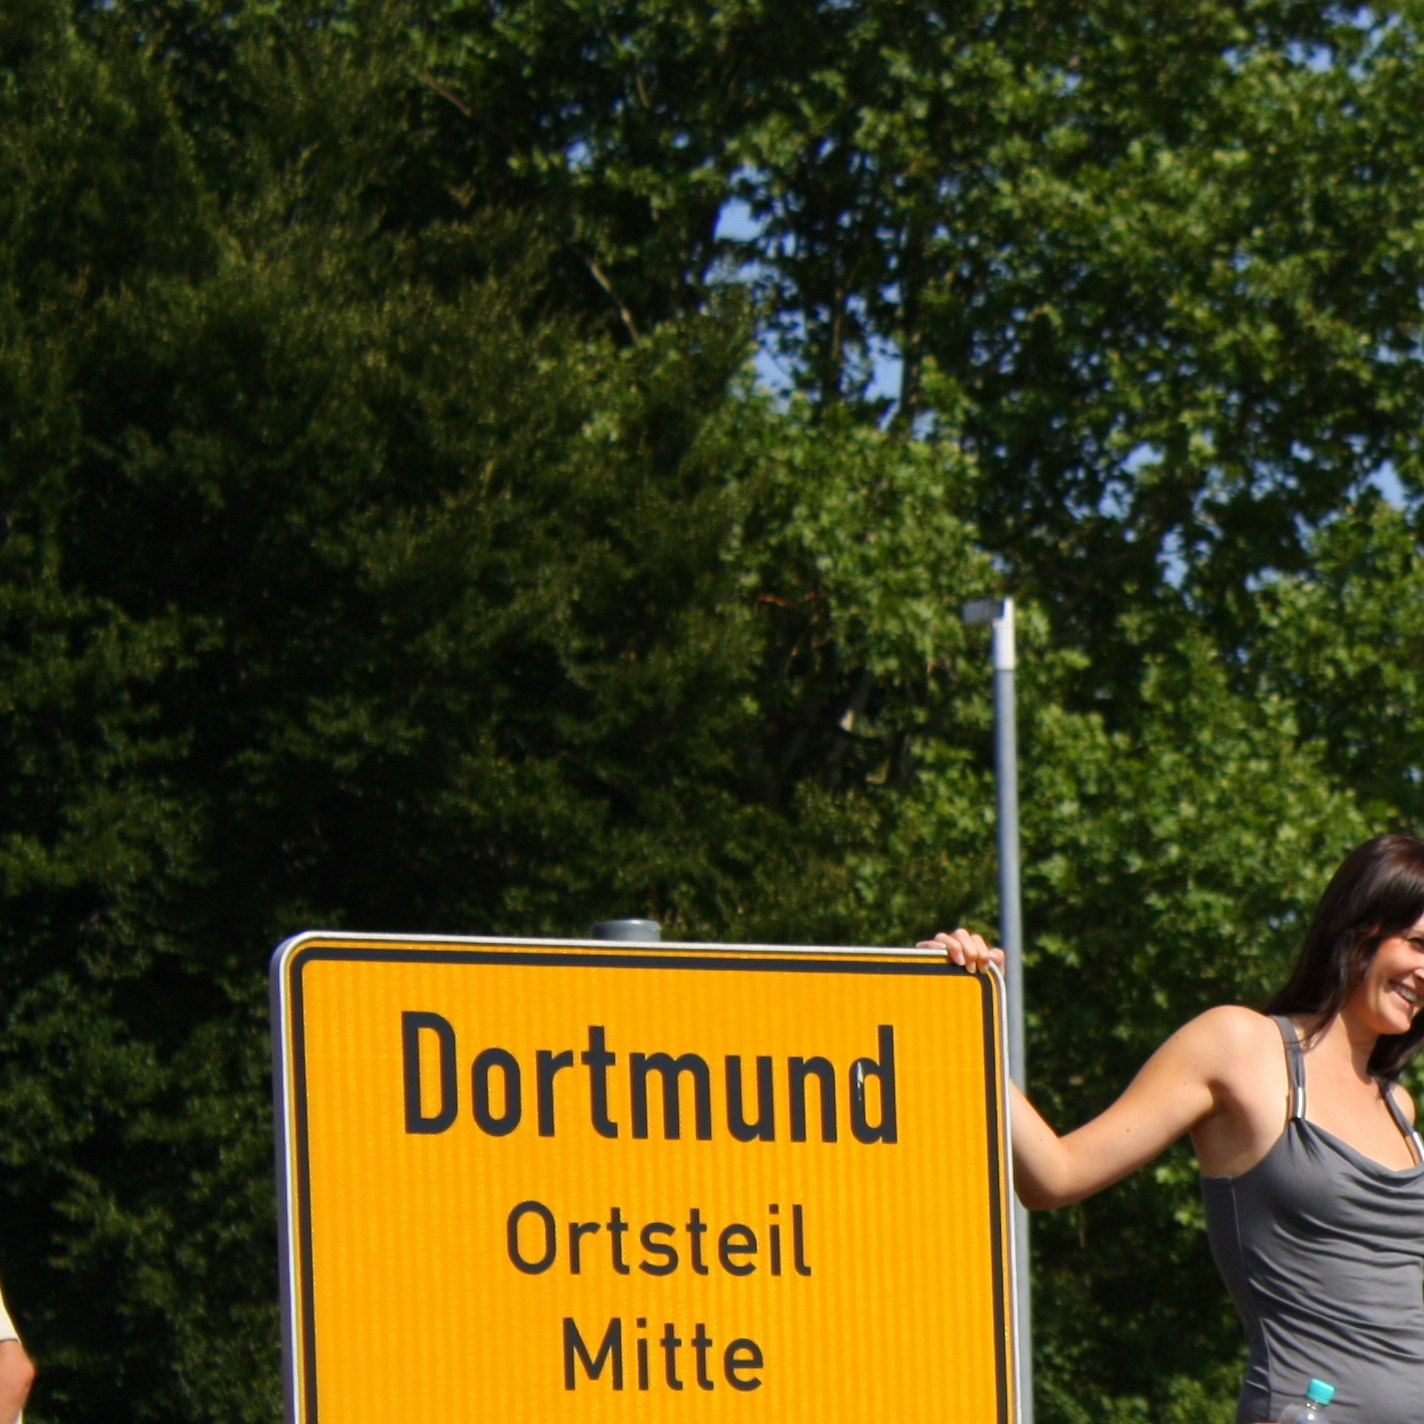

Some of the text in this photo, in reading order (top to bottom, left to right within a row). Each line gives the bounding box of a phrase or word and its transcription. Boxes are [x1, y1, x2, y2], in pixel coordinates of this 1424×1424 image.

[402, 1010, 898, 1145] Dortmund
[506, 1200, 812, 1277] Ortsteil
[562, 1316, 764, 1392] Mitte
